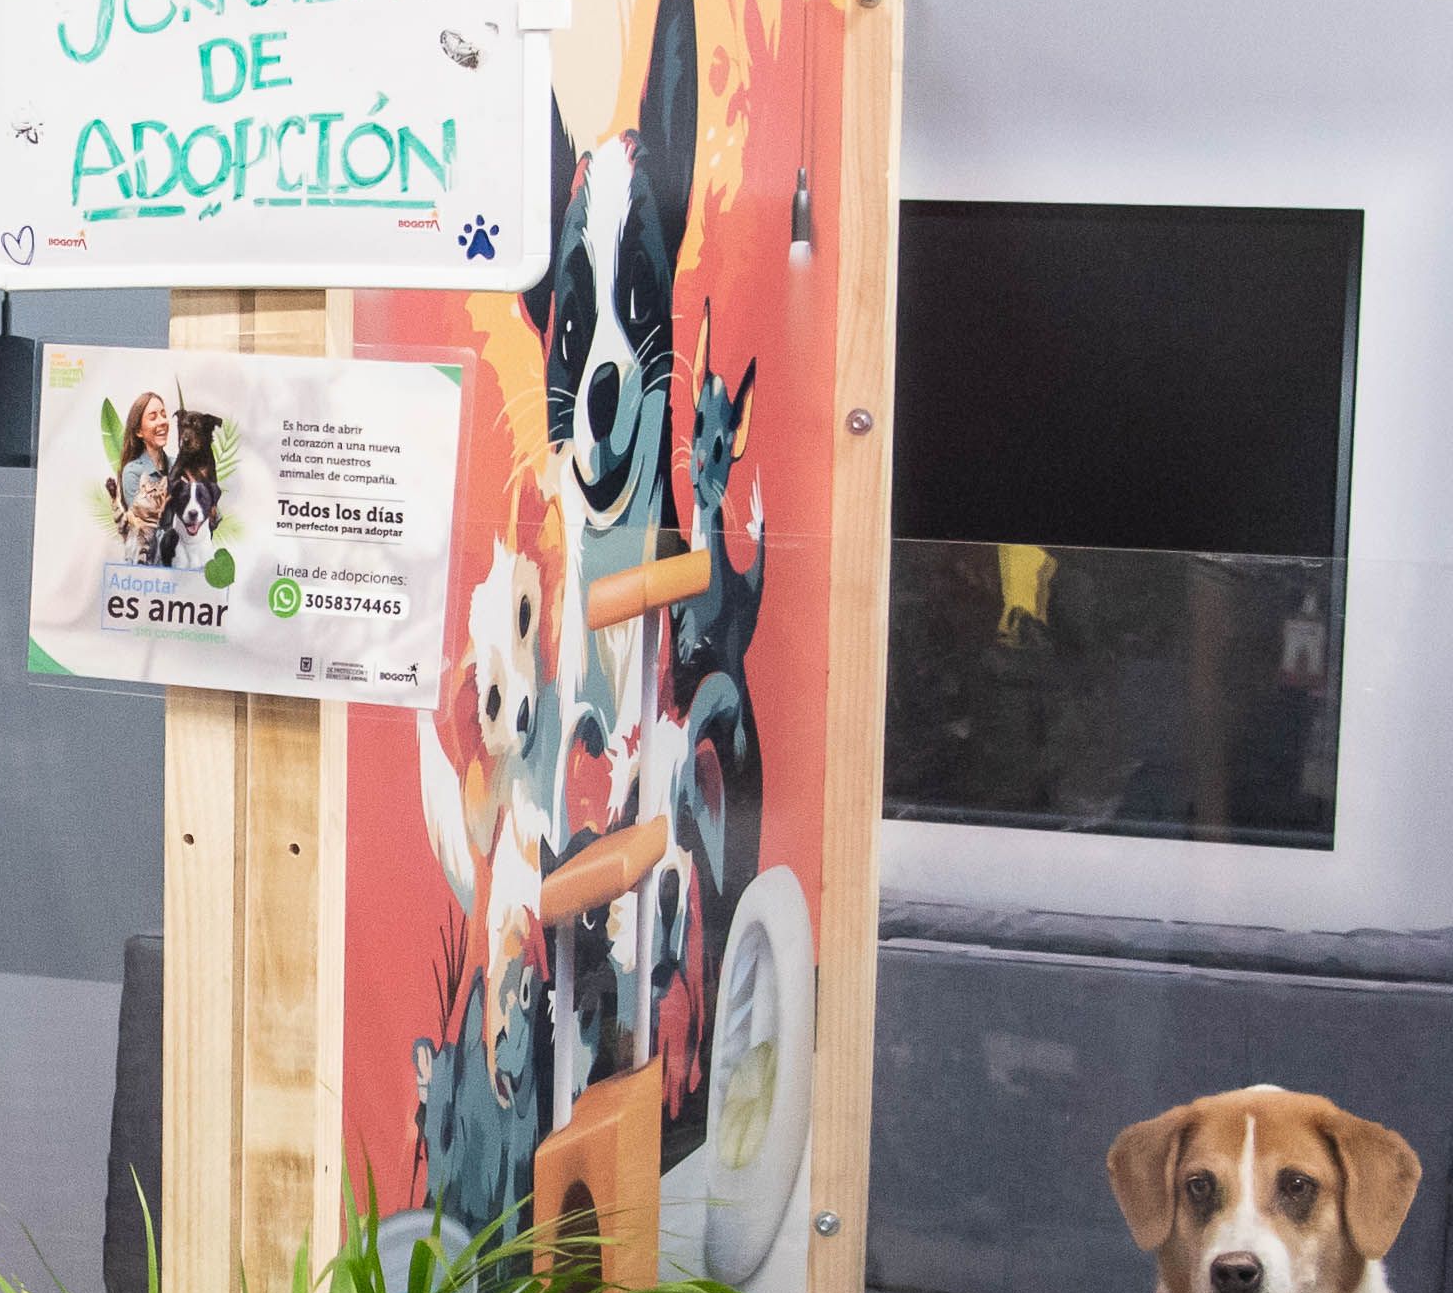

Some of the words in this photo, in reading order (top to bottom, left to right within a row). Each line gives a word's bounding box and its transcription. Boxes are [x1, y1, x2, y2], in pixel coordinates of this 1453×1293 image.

[198, 31, 293, 104] DE
[72, 91, 457, 207] ADOPCIÓN
[283, 420, 294, 431] Es
[296, 421, 320, 433] hora
[322, 423, 335, 434] de
[338, 424, 363, 435] abrir
[281, 436, 291, 447] el
[337, 441, 343, 450] a
[346, 442, 366, 452] una
[369, 444, 401, 454] nueva
[280, 452, 301, 464] vida
[304, 455, 323, 465] con
[326, 456, 372, 468] nuestros
[279, 467, 325, 481] animales
[327, 470, 340, 482] de
[278, 499, 331, 520] Todos
[336, 503, 361, 521] los
[366, 505, 404, 524] días
[276, 520, 293, 530] son
[295, 521, 339, 533] perfectos
[341, 525, 363, 536] para
[365, 526, 404, 538] adoptar
[109, 573, 178, 596] Adoptar
[276, 562, 308, 578] Línea
[312, 566, 327, 580] de
[331, 569, 409, 587] adopciones:
[107, 595, 140, 620] es
[148, 598, 229, 627] amar
[304, 593, 402, 615] 3058374465
